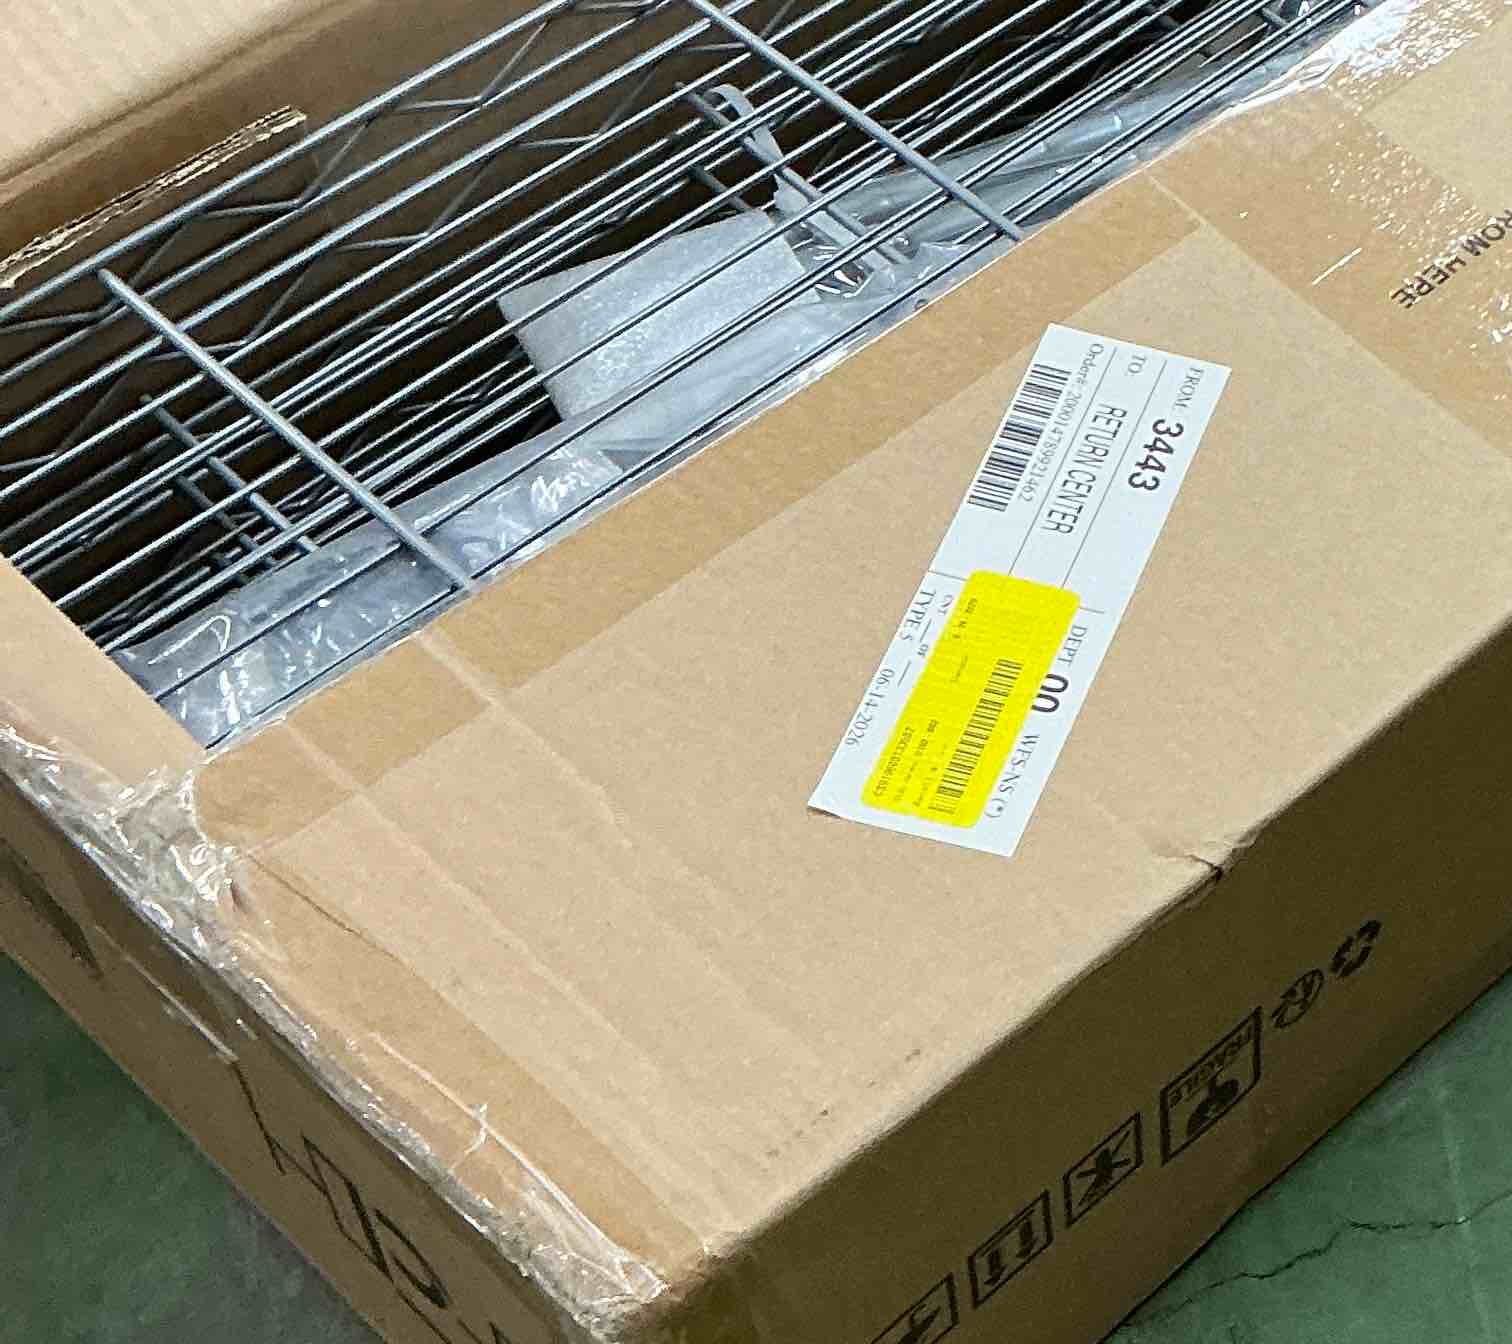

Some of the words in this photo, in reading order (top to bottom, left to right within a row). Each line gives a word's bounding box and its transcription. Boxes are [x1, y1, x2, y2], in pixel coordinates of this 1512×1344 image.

[1391, 256, 1466, 309] HERE
[1072, 403, 1127, 468] RETURN
[1127, 418, 1185, 491] 3443
[1041, 468, 1090, 535] CENTER
[903, 589, 935, 630] TYPE
[1056, 625, 1088, 666] DEPT
[845, 668, 895, 747] 06-14-2026
[1169, 1023, 1253, 1109] FRAGILE
